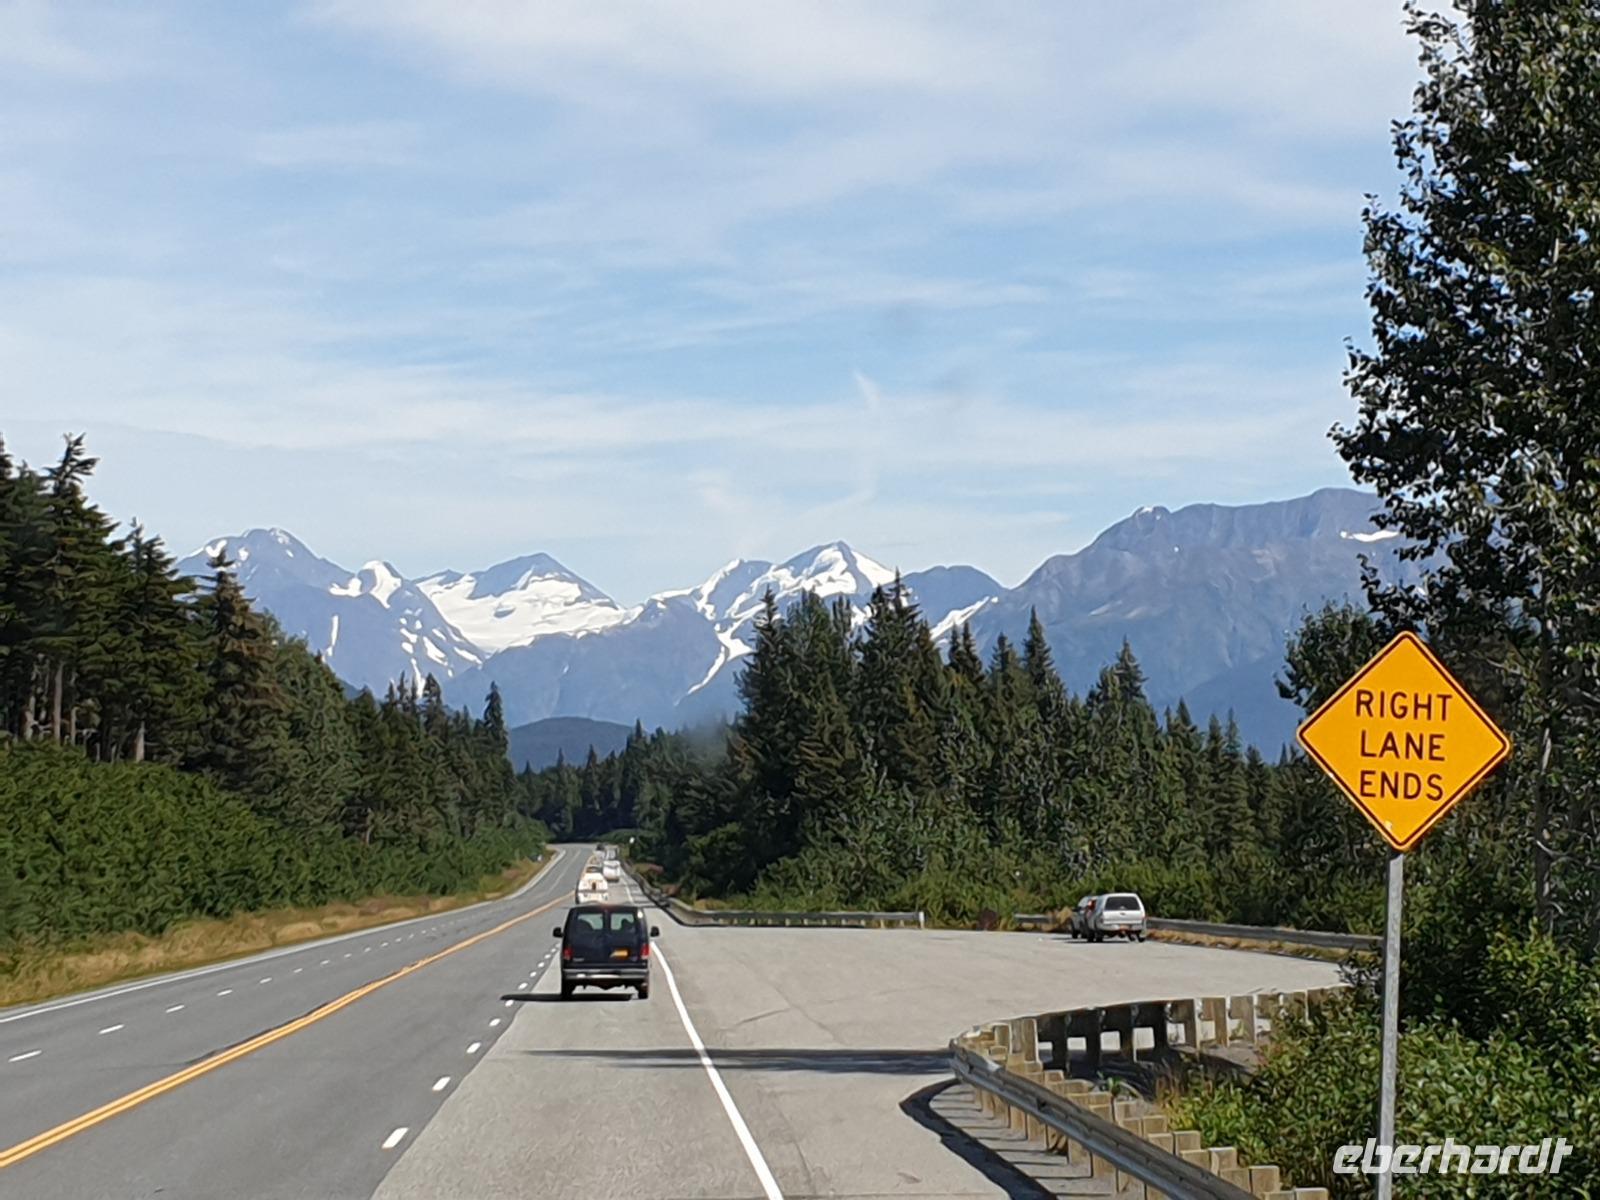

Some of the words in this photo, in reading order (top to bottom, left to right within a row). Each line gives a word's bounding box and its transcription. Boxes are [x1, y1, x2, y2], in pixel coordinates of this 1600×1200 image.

[1356, 690, 1452, 721] RIGHT
[1361, 731, 1445, 761] LANE
[1361, 771, 1444, 801] ENDS
